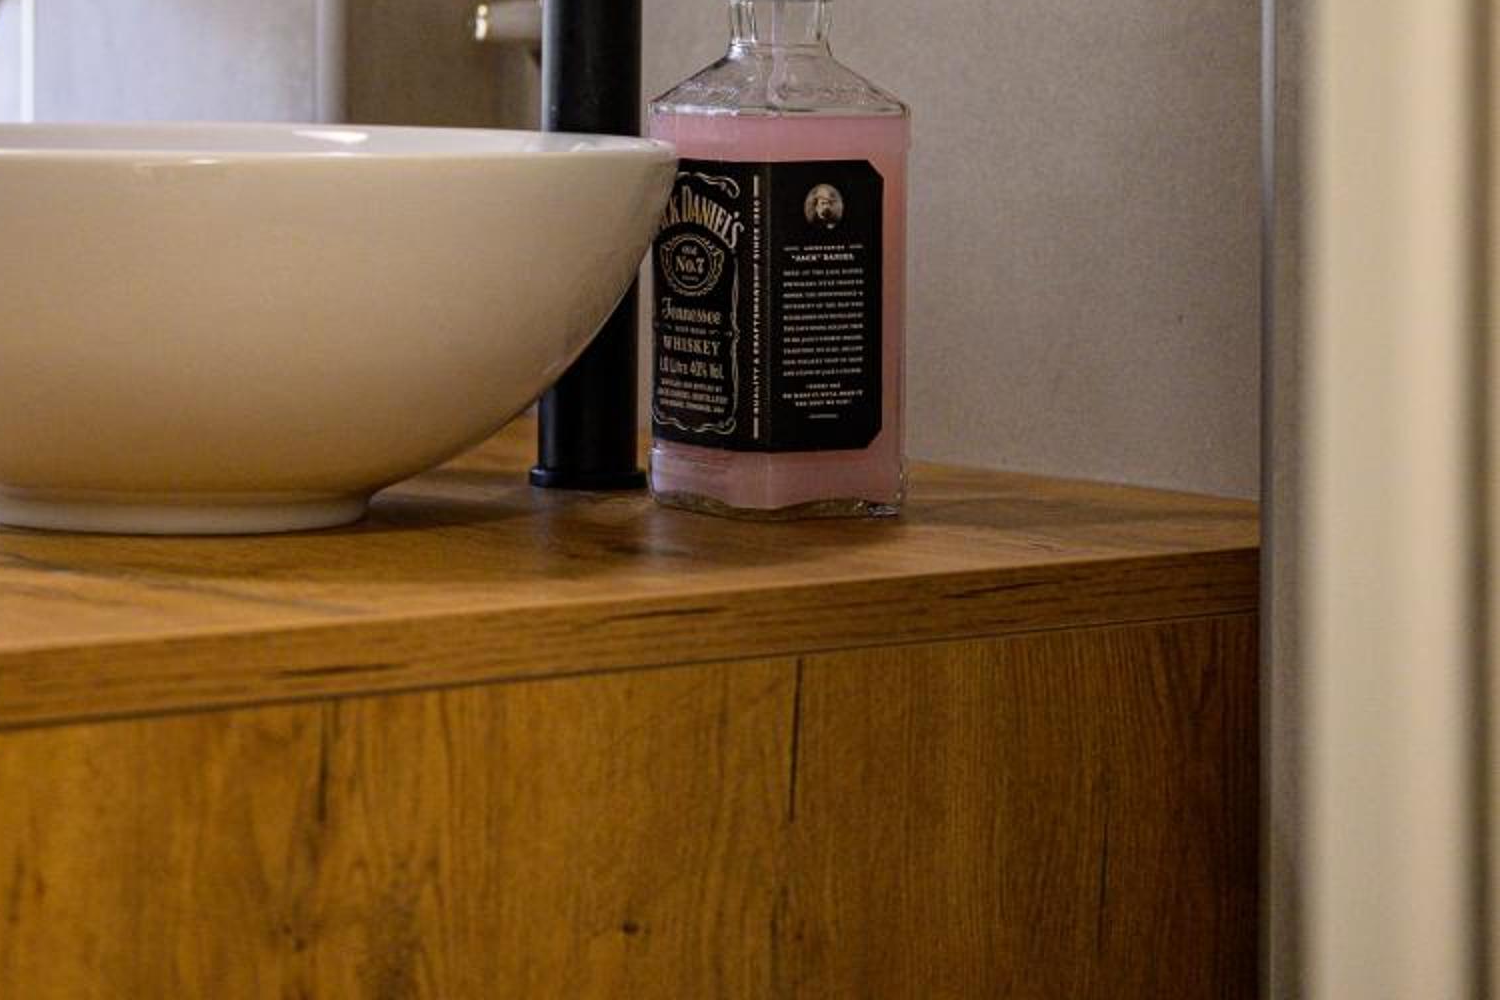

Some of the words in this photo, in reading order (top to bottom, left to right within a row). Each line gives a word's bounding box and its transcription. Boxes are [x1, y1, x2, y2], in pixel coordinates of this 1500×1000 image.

[681, 185, 745, 250] DANIEL'S
[675, 255, 705, 275] No.7
[661, 297, 722, 325] Tennessee
[663, 335, 721, 356] WHISKEY
